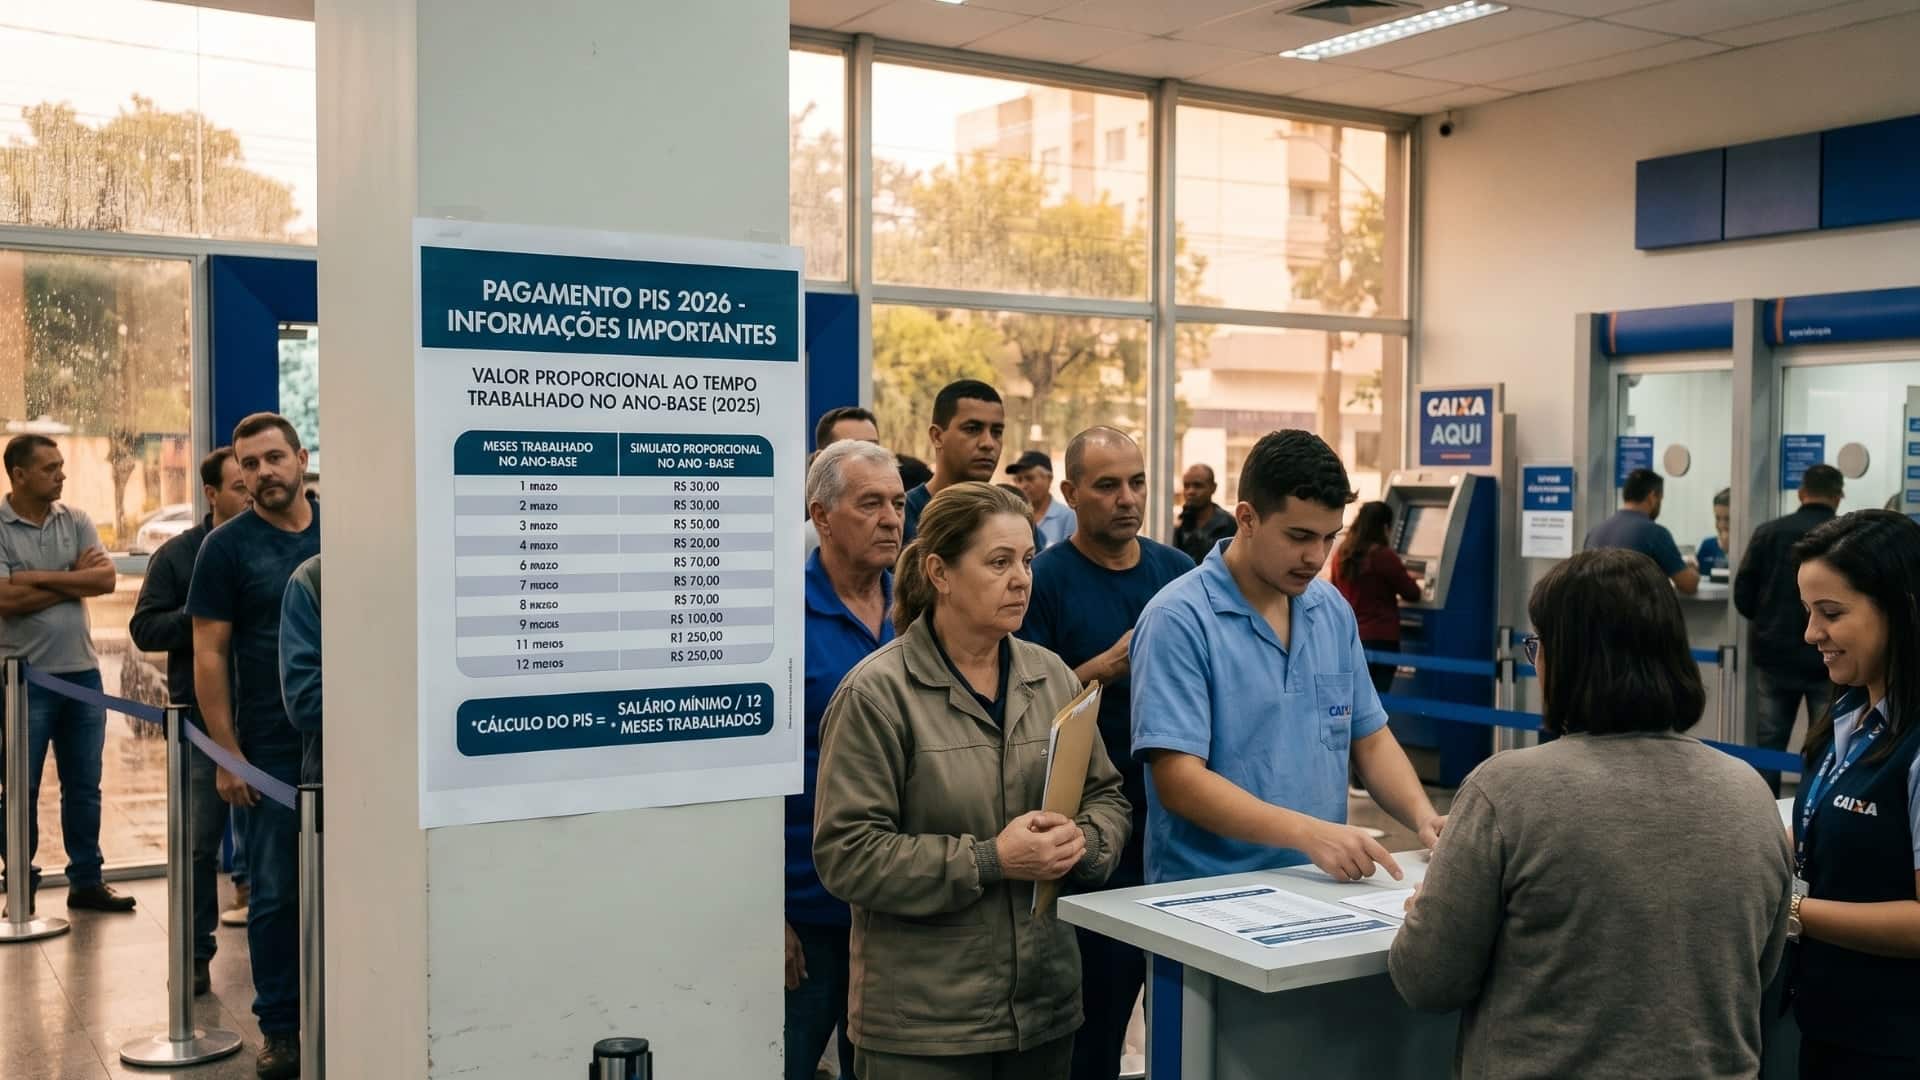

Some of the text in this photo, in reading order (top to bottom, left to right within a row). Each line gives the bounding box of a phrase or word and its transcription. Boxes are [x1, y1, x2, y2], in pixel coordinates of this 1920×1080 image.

[483, 280, 632, 309] PAGAMENTO
[639, 288, 670, 310] PIS
[678, 291, 732, 314] 2026
[448, 309, 777, 346] INFORMAÇÕES IMPORTANTES
[472, 367, 757, 391] VALOR PROPORCIONAL AO TEMPO
[468, 390, 760, 415] TRABALHADO NO ANO-BASE (2025)
[1426, 396, 1485, 417] CAIXA
[1430, 423, 1482, 445] AQUI
[483, 441, 593, 453] MESES TRABALHADO
[630, 442, 761, 455] SIMULATO PROPORCIONAL
[499, 455, 577, 468] NO ANO-BASE
[657, 457, 676, 469] NO
[677, 458, 702, 469] ANO
[690, 481, 720, 492] 30,00
[520, 500, 527, 511] 2
[690, 500, 720, 511] 30,00
[520, 520, 527, 531] 3
[690, 518, 720, 531] 50,00
[520, 540, 527, 550] 4
[690, 537, 720, 550] 20,00
[520, 560, 527, 571] 6
[690, 556, 720, 568] 70,00
[520, 580, 527, 591] 7
[690, 575, 720, 587] 70,00
[520, 599, 527, 610] 8
[690, 593, 720, 606] 70,00
[688, 612, 723, 624] 100,00
[520, 619, 527, 630] 9
[687, 630, 723, 643] 250,00
[517, 640, 528, 650] 11
[687, 649, 723, 661] 250,00
[517, 659, 529, 670] 12
[618, 694, 761, 715] SALÁRIO MÍNIMO / 12
[547, 715, 570, 729] DO
[573, 713, 593, 727] PIS
[596, 715, 606, 725] =
[620, 718, 663, 734] MESES
[666, 713, 761, 731] TRABALHADOS
[1833, 794, 1878, 817] CAIXA
